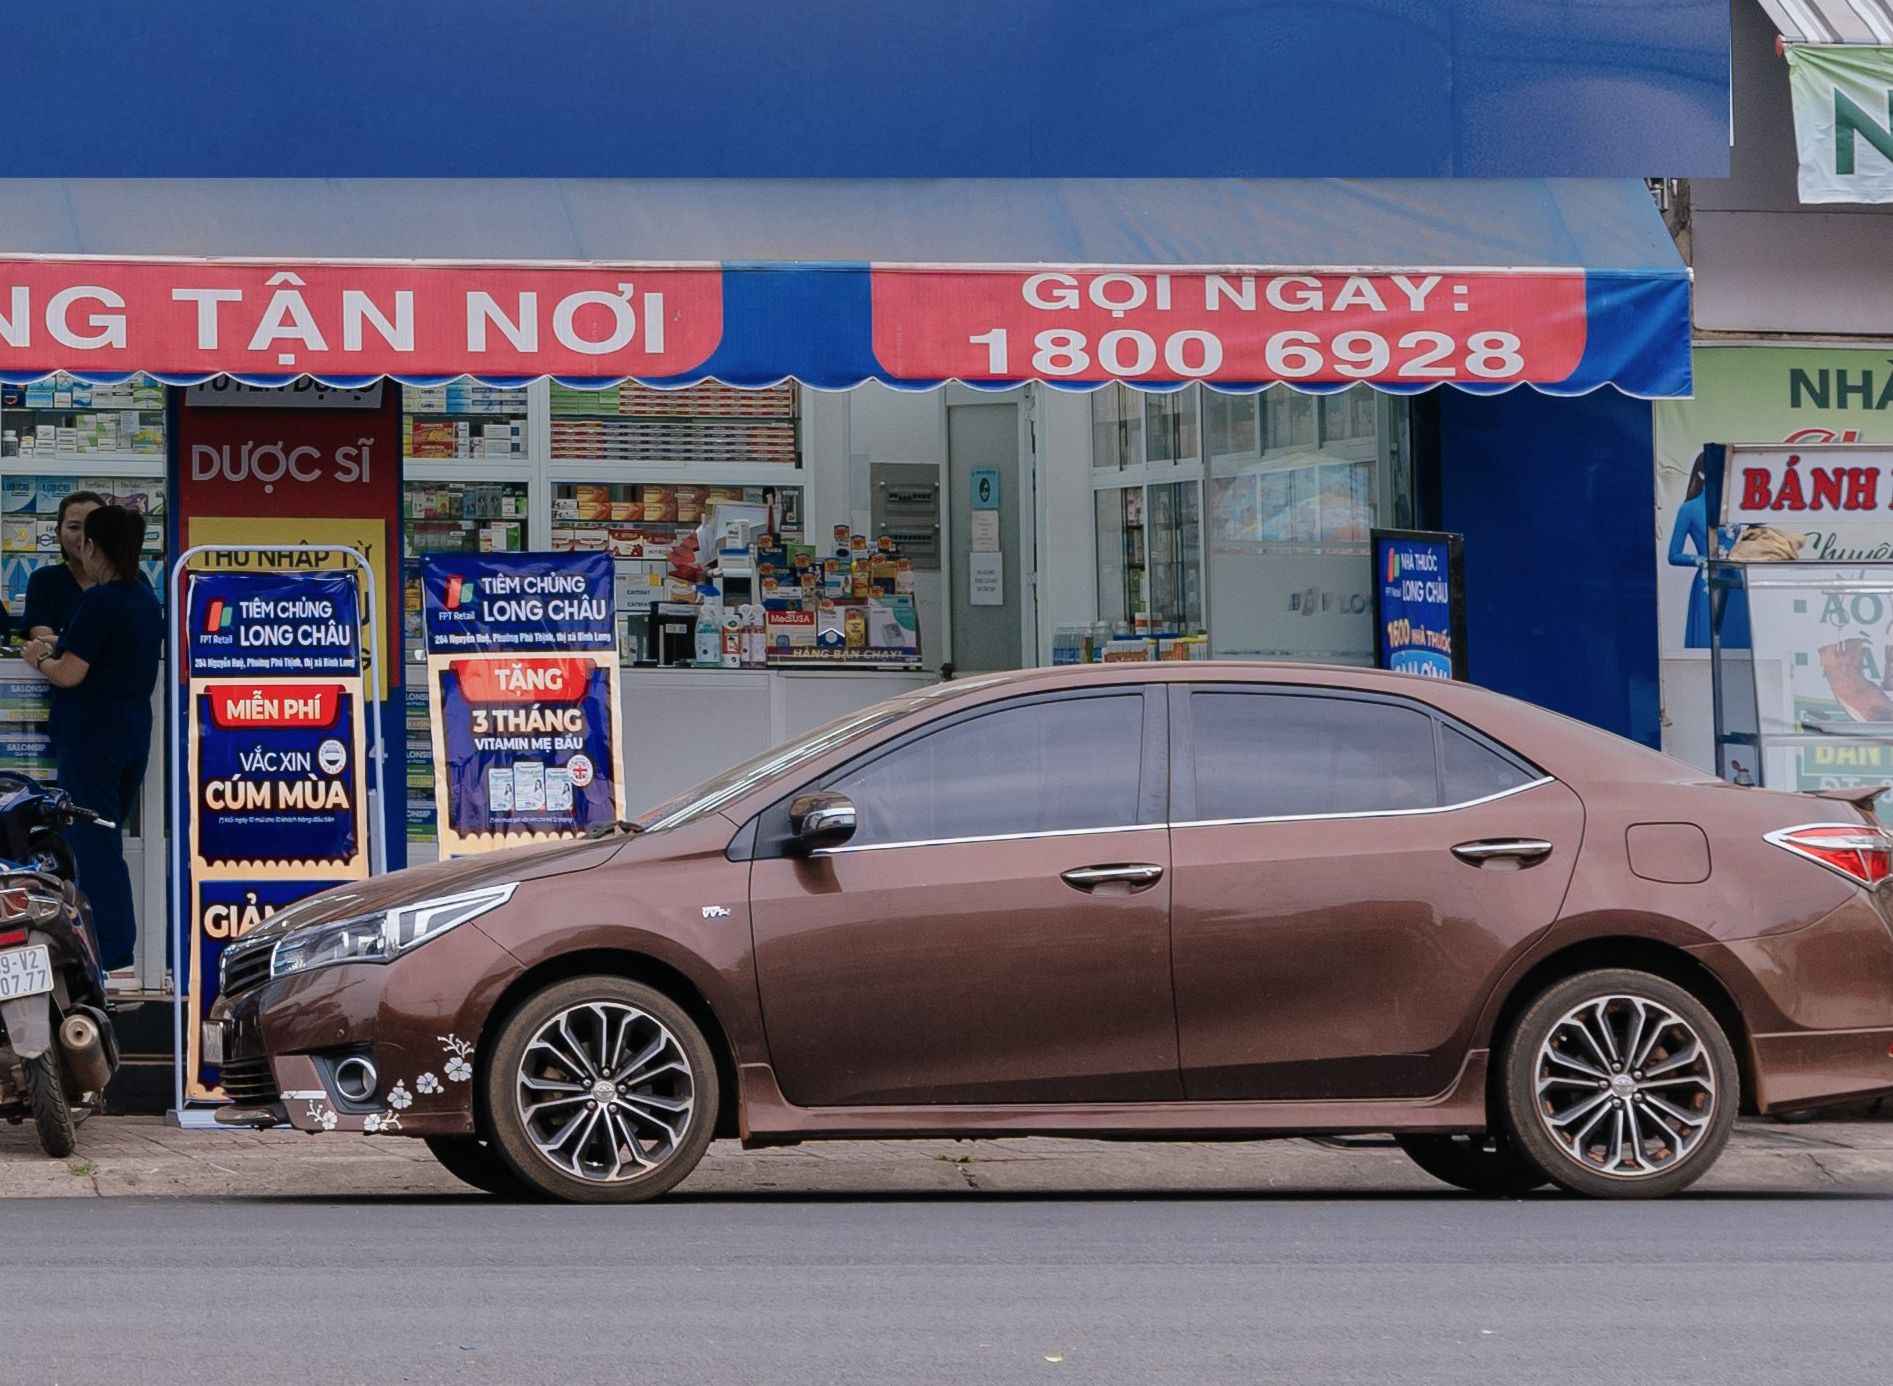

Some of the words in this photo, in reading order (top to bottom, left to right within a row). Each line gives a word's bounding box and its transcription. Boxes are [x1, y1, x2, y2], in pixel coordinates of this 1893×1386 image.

[173, 271, 416, 366] TẬN
[466, 279, 666, 357] NƠI
[1022, 272, 1173, 318] GỌI
[1206, 274, 1470, 313] NGAY:
[968, 328, 1225, 376] 1800
[1264, 329, 1526, 379] 6928
[192, 441, 322, 494] DƯỢC
[334, 438, 374, 483] SĨ
[1740, 456, 1878, 511] BÁNH
[1403, 580, 1424, 603] LONG
[281, 752, 311, 772] XIN
